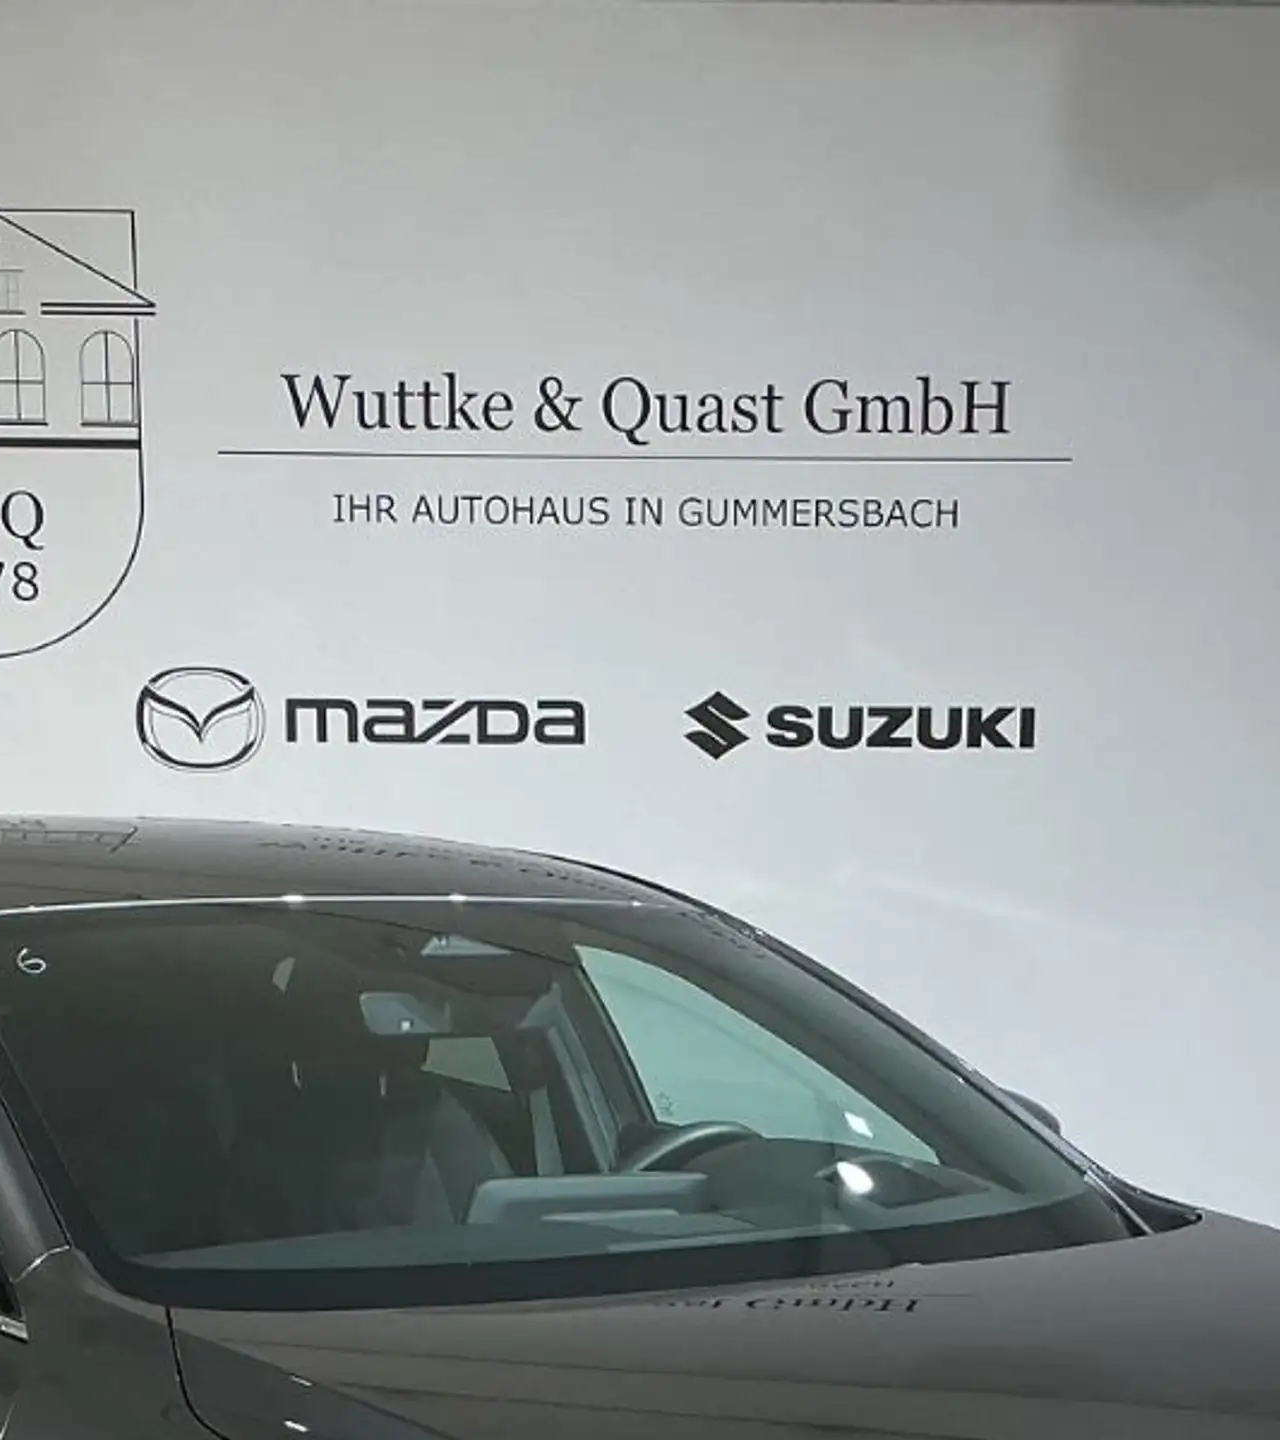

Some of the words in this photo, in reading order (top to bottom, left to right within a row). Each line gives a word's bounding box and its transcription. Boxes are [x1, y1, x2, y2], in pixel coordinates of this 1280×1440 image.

[280, 371, 513, 432] Wuttke
[534, 376, 583, 432] &
[602, 377, 784, 446] Quast
[805, 375, 1012, 435] GmbH
[332, 494, 398, 523] IHR
[411, 495, 610, 526] AUTOHAUS
[624, 497, 663, 526] IN
[679, 497, 959, 528] GUMMERSBACH
[765, 705, 1037, 752] SUZUKI
